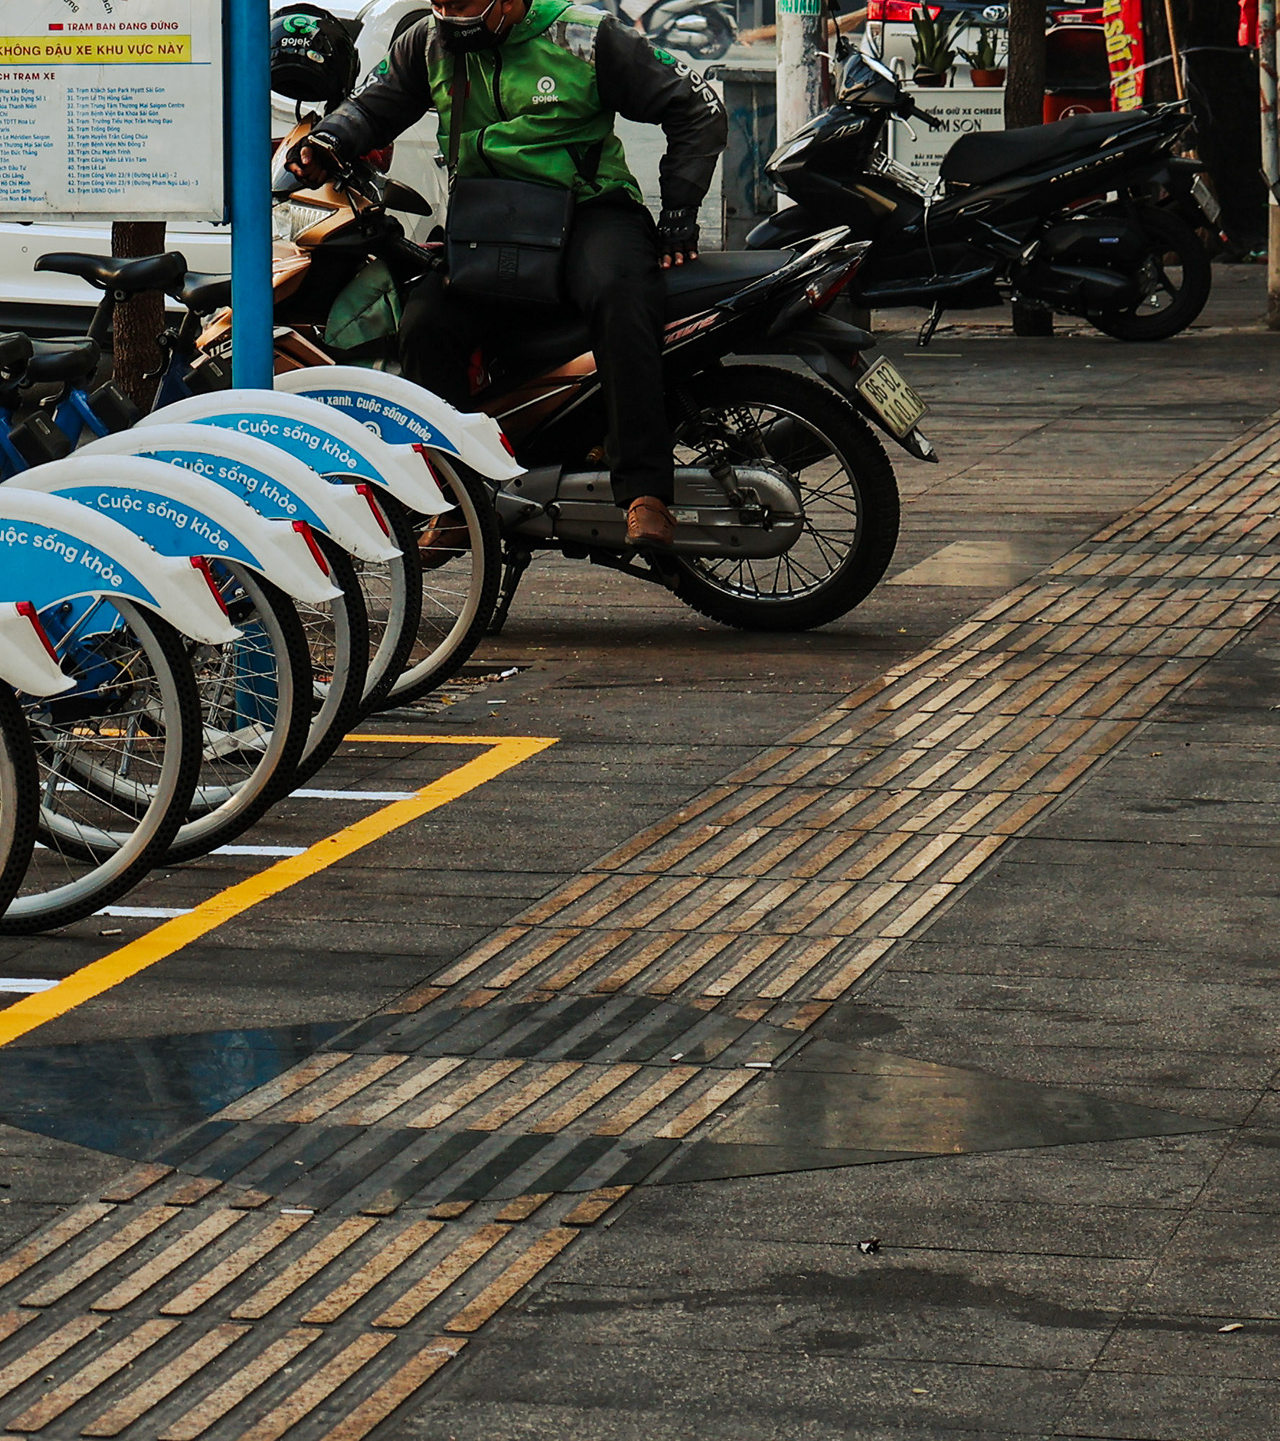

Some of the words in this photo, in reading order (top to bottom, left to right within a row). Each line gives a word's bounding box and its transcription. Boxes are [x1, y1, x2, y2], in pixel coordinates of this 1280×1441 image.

[68, 23, 93, 33] TRẠM
[97, 22, 116, 33] BẠN
[119, 22, 147, 31] ĐANG
[151, 20, 179, 31] ĐỨNG
[45, 43, 71, 58] ĐẬU
[76, 45, 92, 55] XE
[97, 45, 123, 55] KHU
[128, 44, 153, 57] VỰC
[157, 42, 184, 55] NÀY
[281, 36, 311, 49] gojek
[13, 72, 40, 82] TRẠM
[43, 72, 56, 81] XE
[673, 65, 722, 115] gojek
[532, 93, 559, 106] gojek
[973, 107, 1002, 115] CHEESE
[326, 396, 354, 408] xanh.
[356, 397, 381, 415] Cuộc
[381, 405, 409, 426] sống
[407, 418, 432, 442] khỏe
[237, 419, 279, 440] Cuộc
[283, 421, 321, 451] sống
[321, 441, 358, 471] khỏe
[97, 492, 142, 514] Cuộc
[146, 498, 189, 529] sống
[189, 516, 230, 552] khỏe
[32, 529, 79, 562] sống
[79, 549, 124, 588] khỏe
